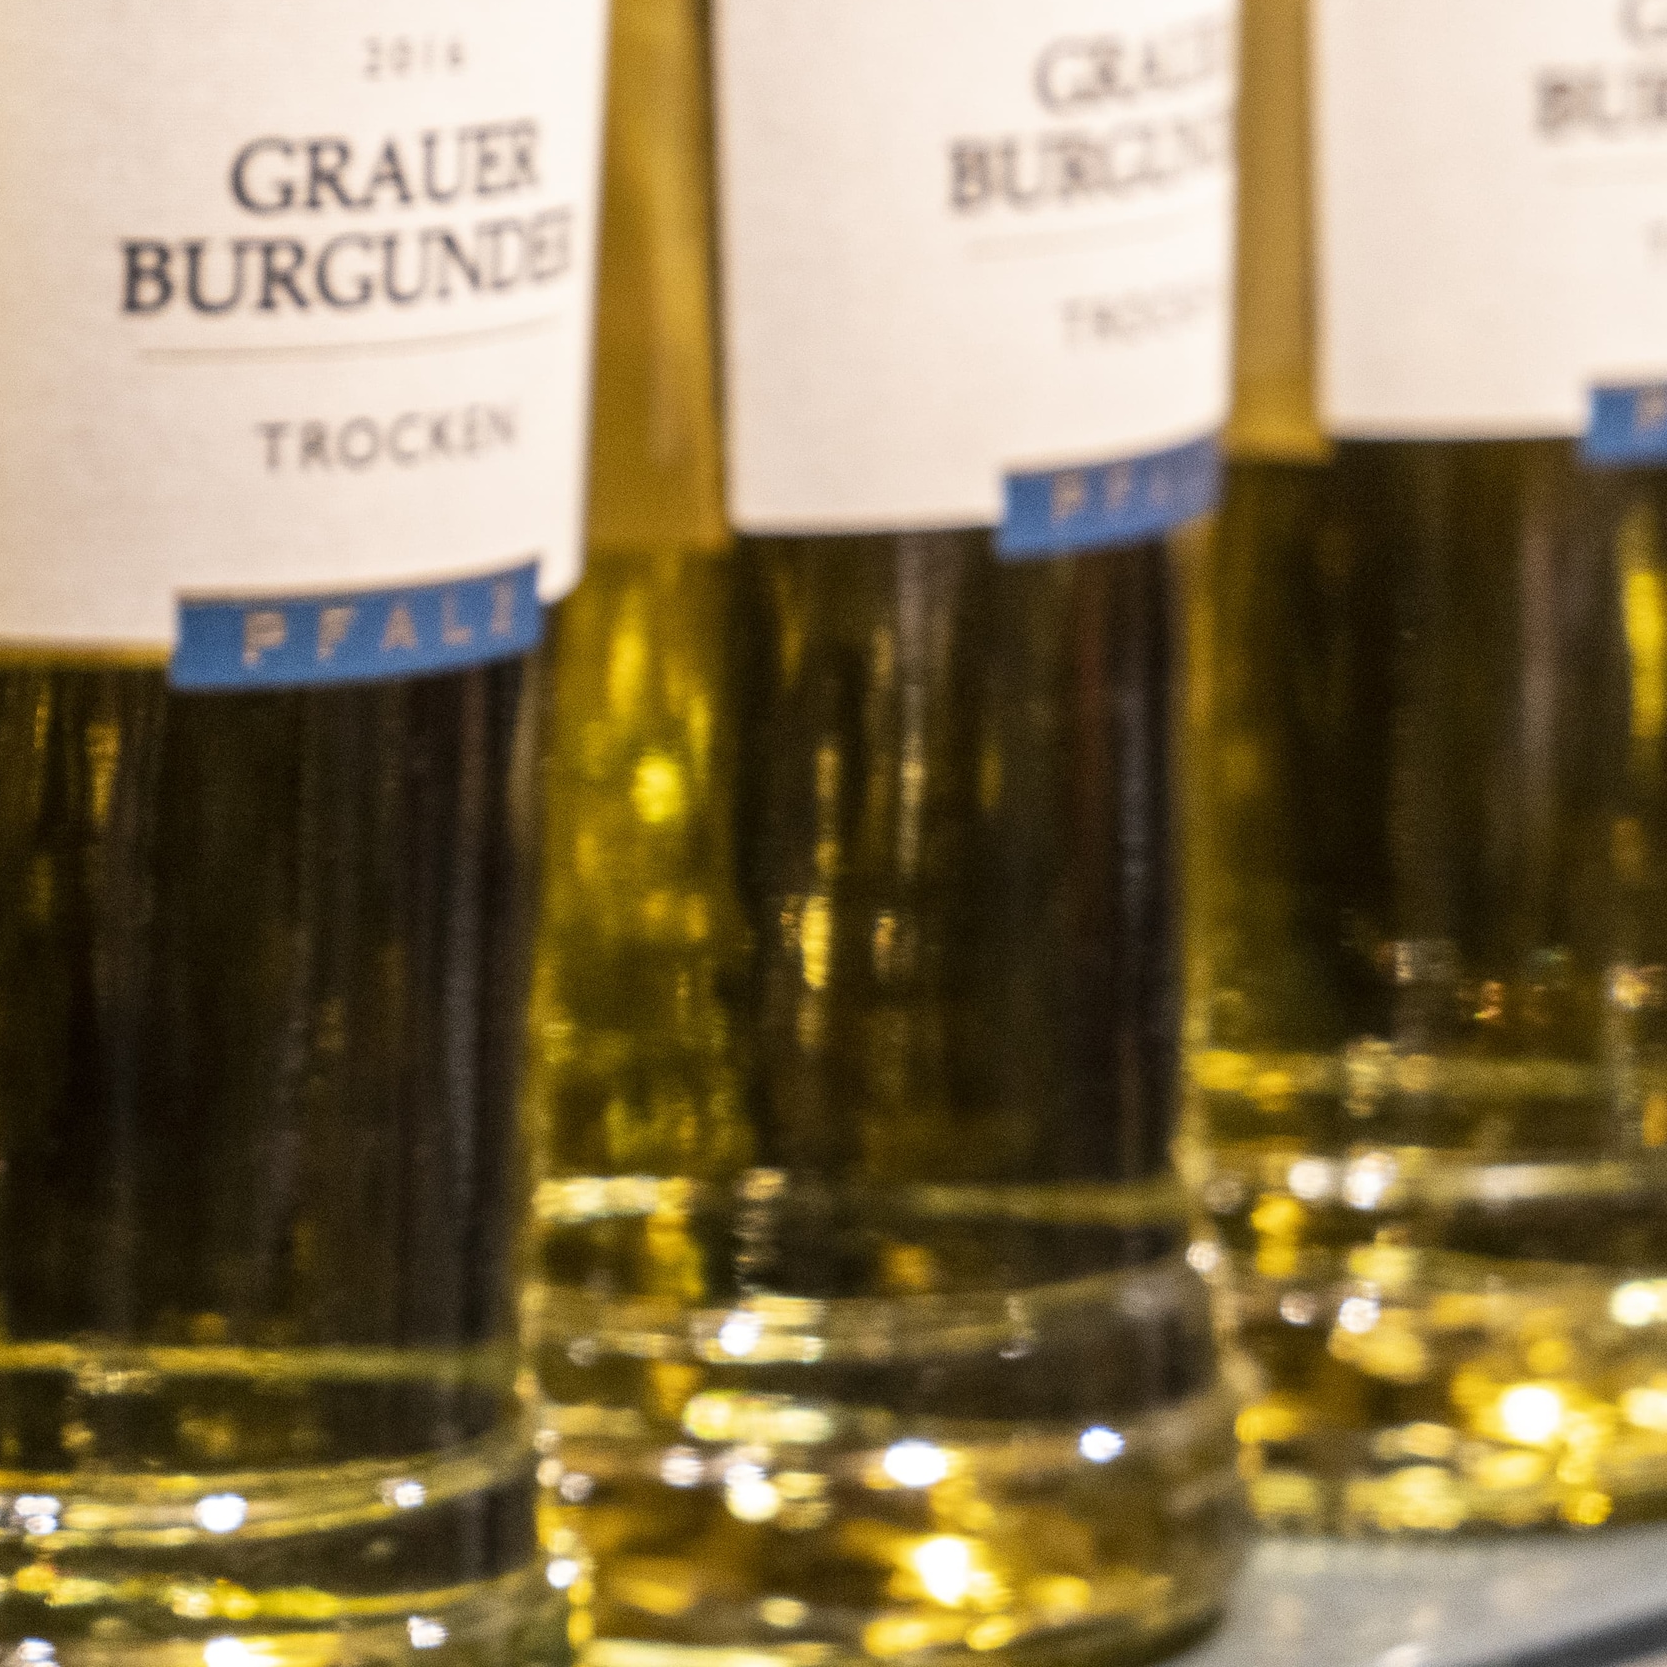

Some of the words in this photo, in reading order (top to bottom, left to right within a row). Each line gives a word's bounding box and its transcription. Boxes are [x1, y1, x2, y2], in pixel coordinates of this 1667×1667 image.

[230, 118, 538, 216] GRAUER
[257, 403, 517, 473] TROCKEN
[242, 580, 514, 666] PFALZ
